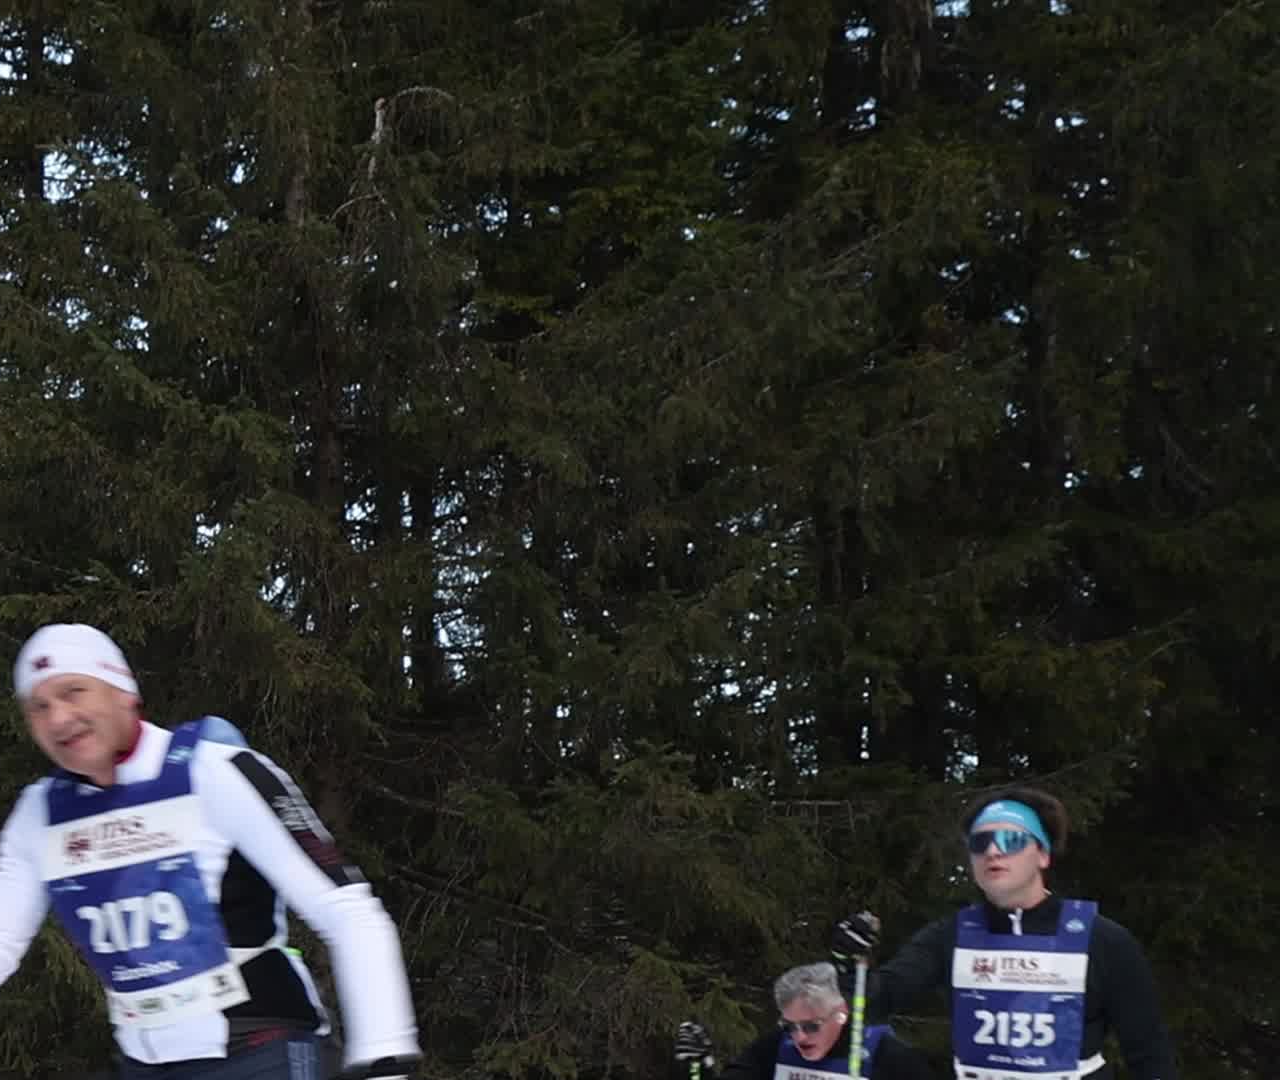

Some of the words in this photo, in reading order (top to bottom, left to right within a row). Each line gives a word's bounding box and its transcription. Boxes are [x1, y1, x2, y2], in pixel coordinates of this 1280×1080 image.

[76, 890, 190, 954] 2179
[1000, 957, 1040, 970] ITAS
[972, 1009, 1058, 1048] 2135
